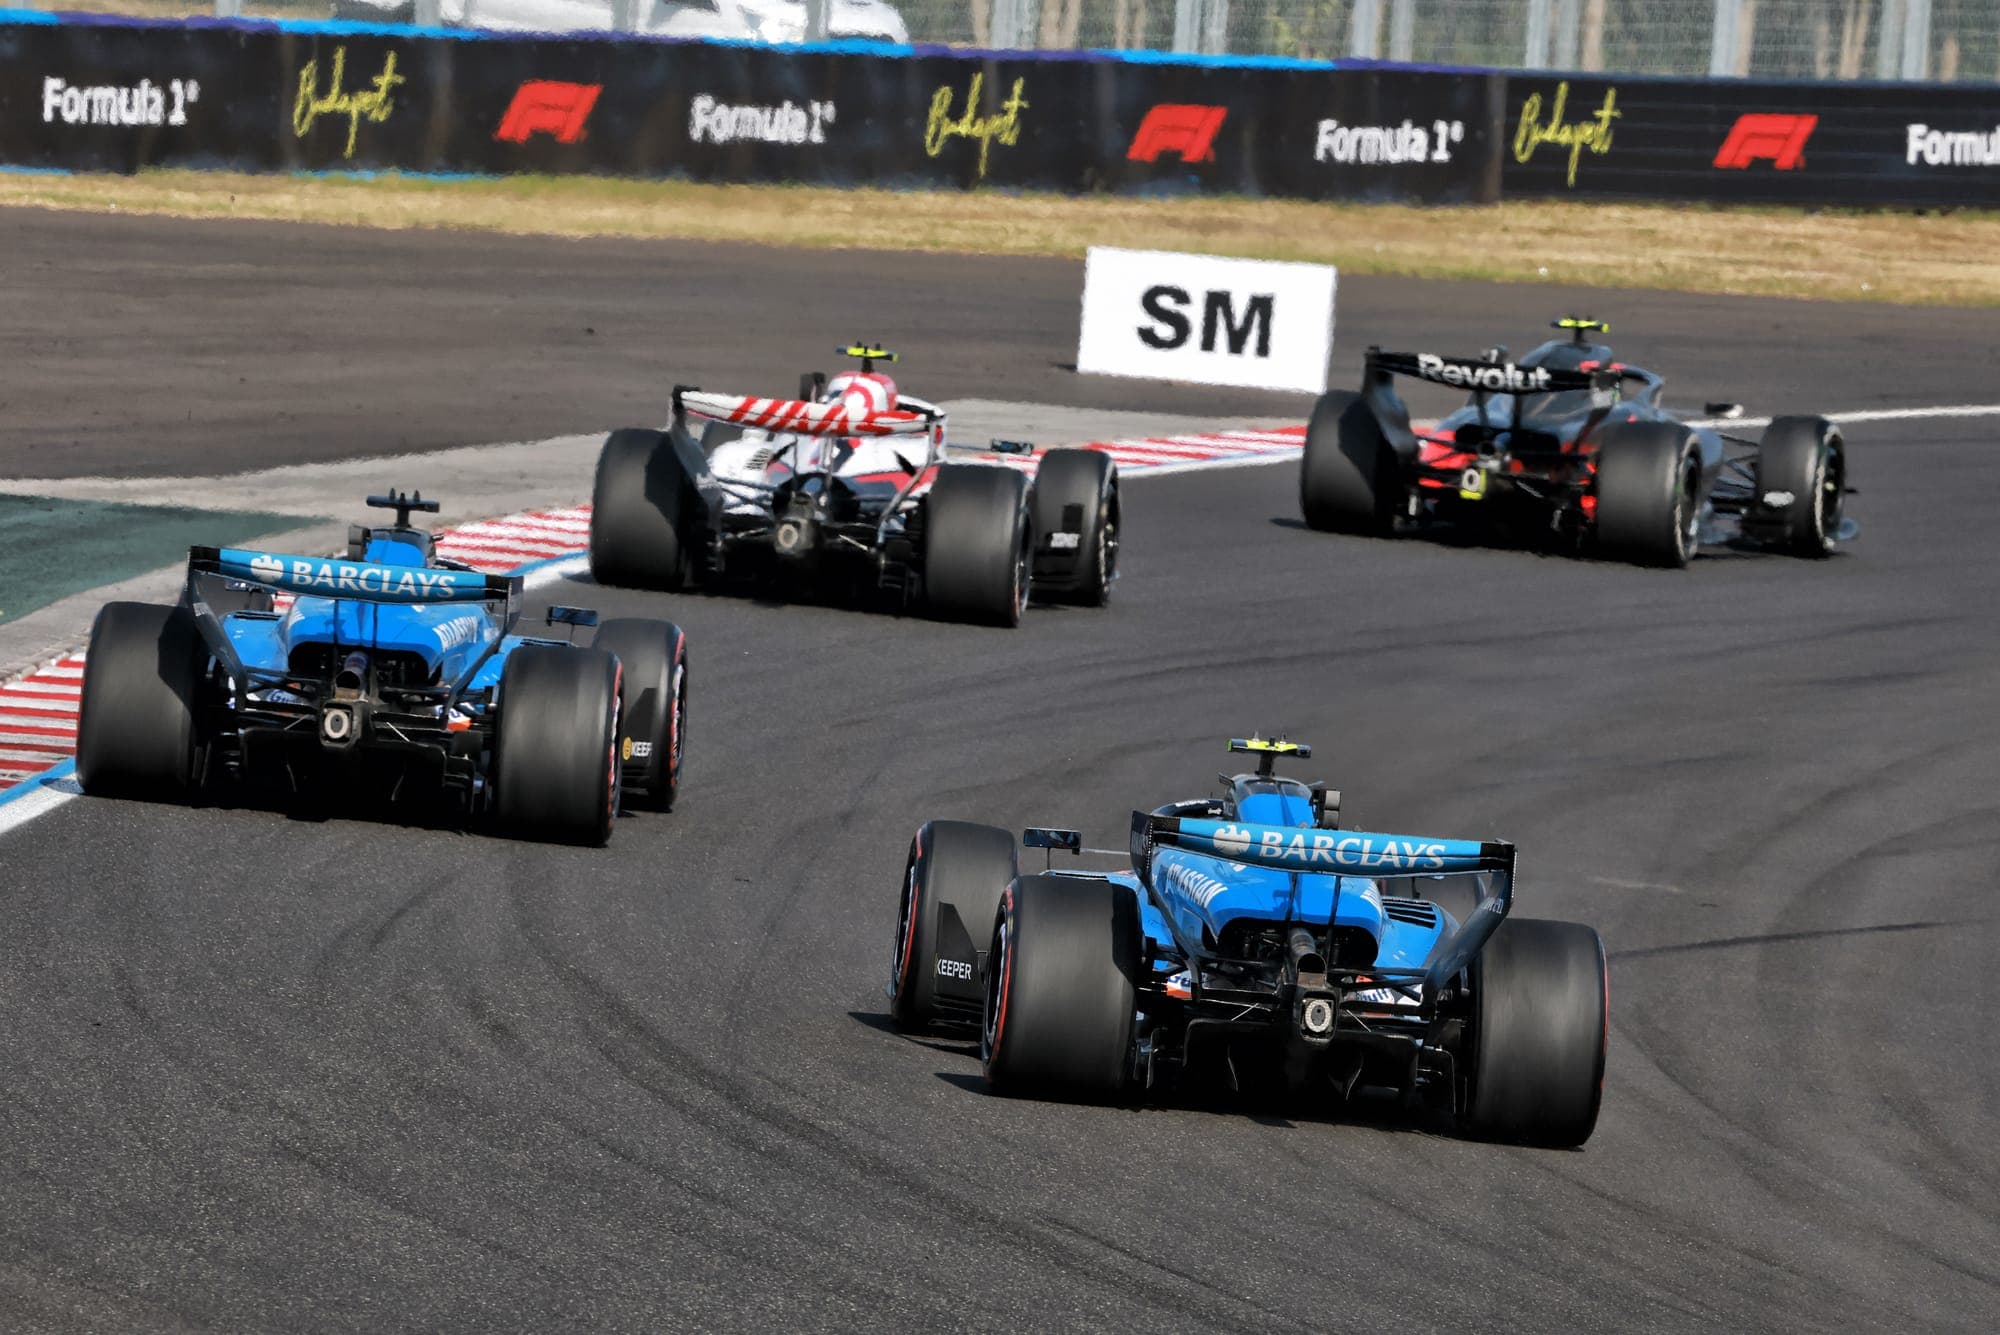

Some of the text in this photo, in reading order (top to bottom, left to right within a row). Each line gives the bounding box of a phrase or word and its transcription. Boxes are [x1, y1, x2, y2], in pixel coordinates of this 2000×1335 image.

[43, 75, 165, 126] Formula
[688, 94, 808, 144] Formula
[1314, 118, 1429, 163] Formula
[1136, 284, 1275, 359] SM
[1417, 352, 1551, 391] Revolut
[292, 559, 457, 599] BARCLAYS
[1258, 830, 1447, 870] BARCLAYS
